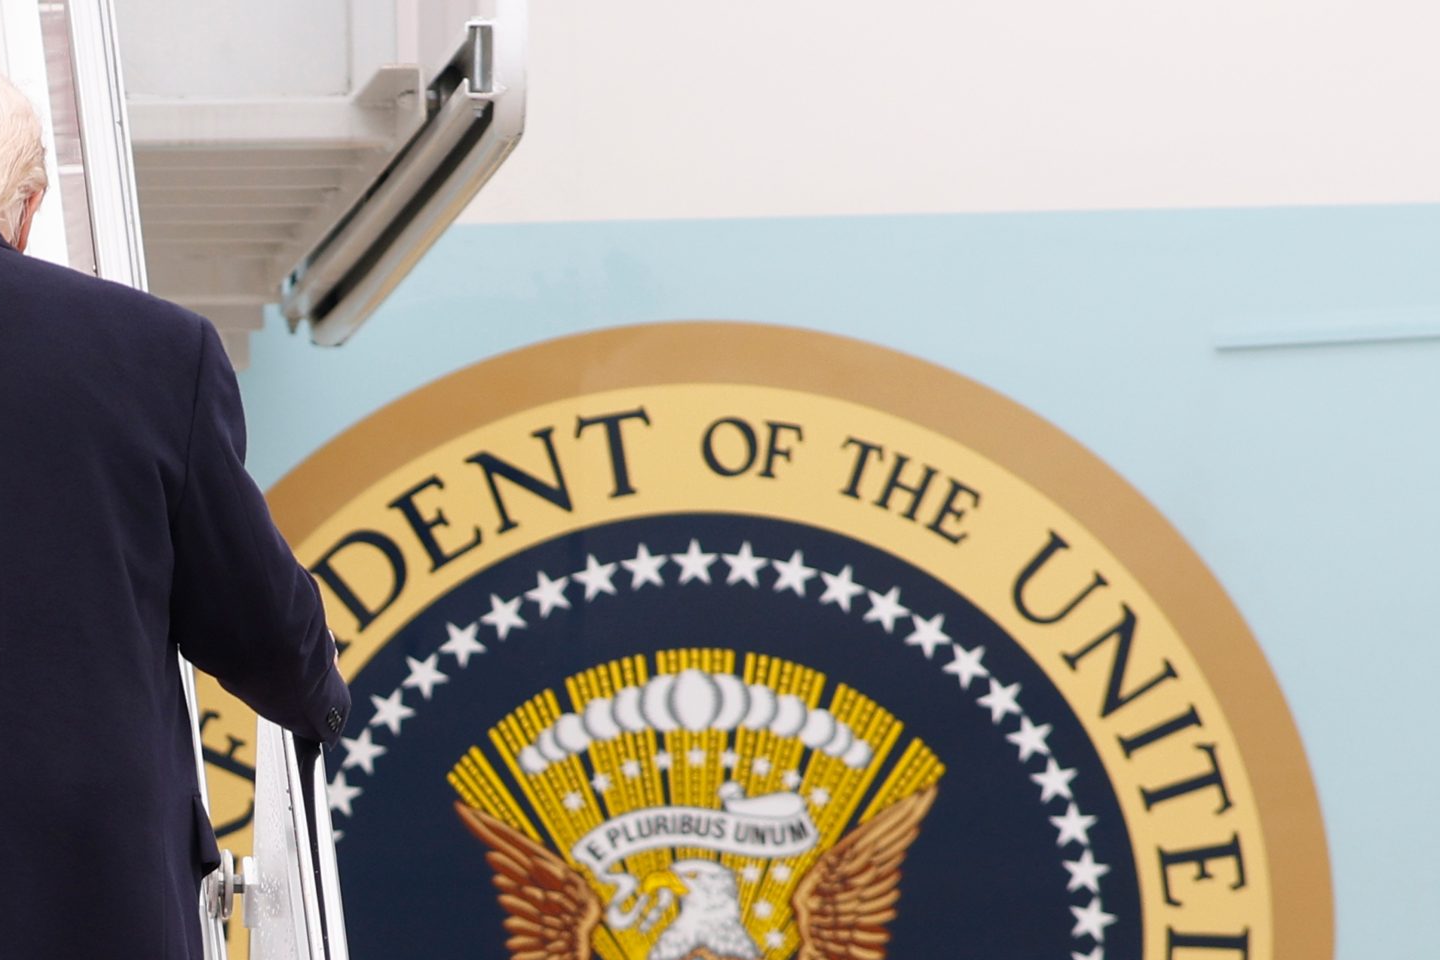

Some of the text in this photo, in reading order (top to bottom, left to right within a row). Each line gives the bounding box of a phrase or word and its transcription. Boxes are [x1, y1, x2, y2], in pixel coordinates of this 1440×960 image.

[701, 417, 803, 479] OF
[841, 437, 980, 545] THE
[585, 813, 809, 862] E PLURIBUS UNUM
